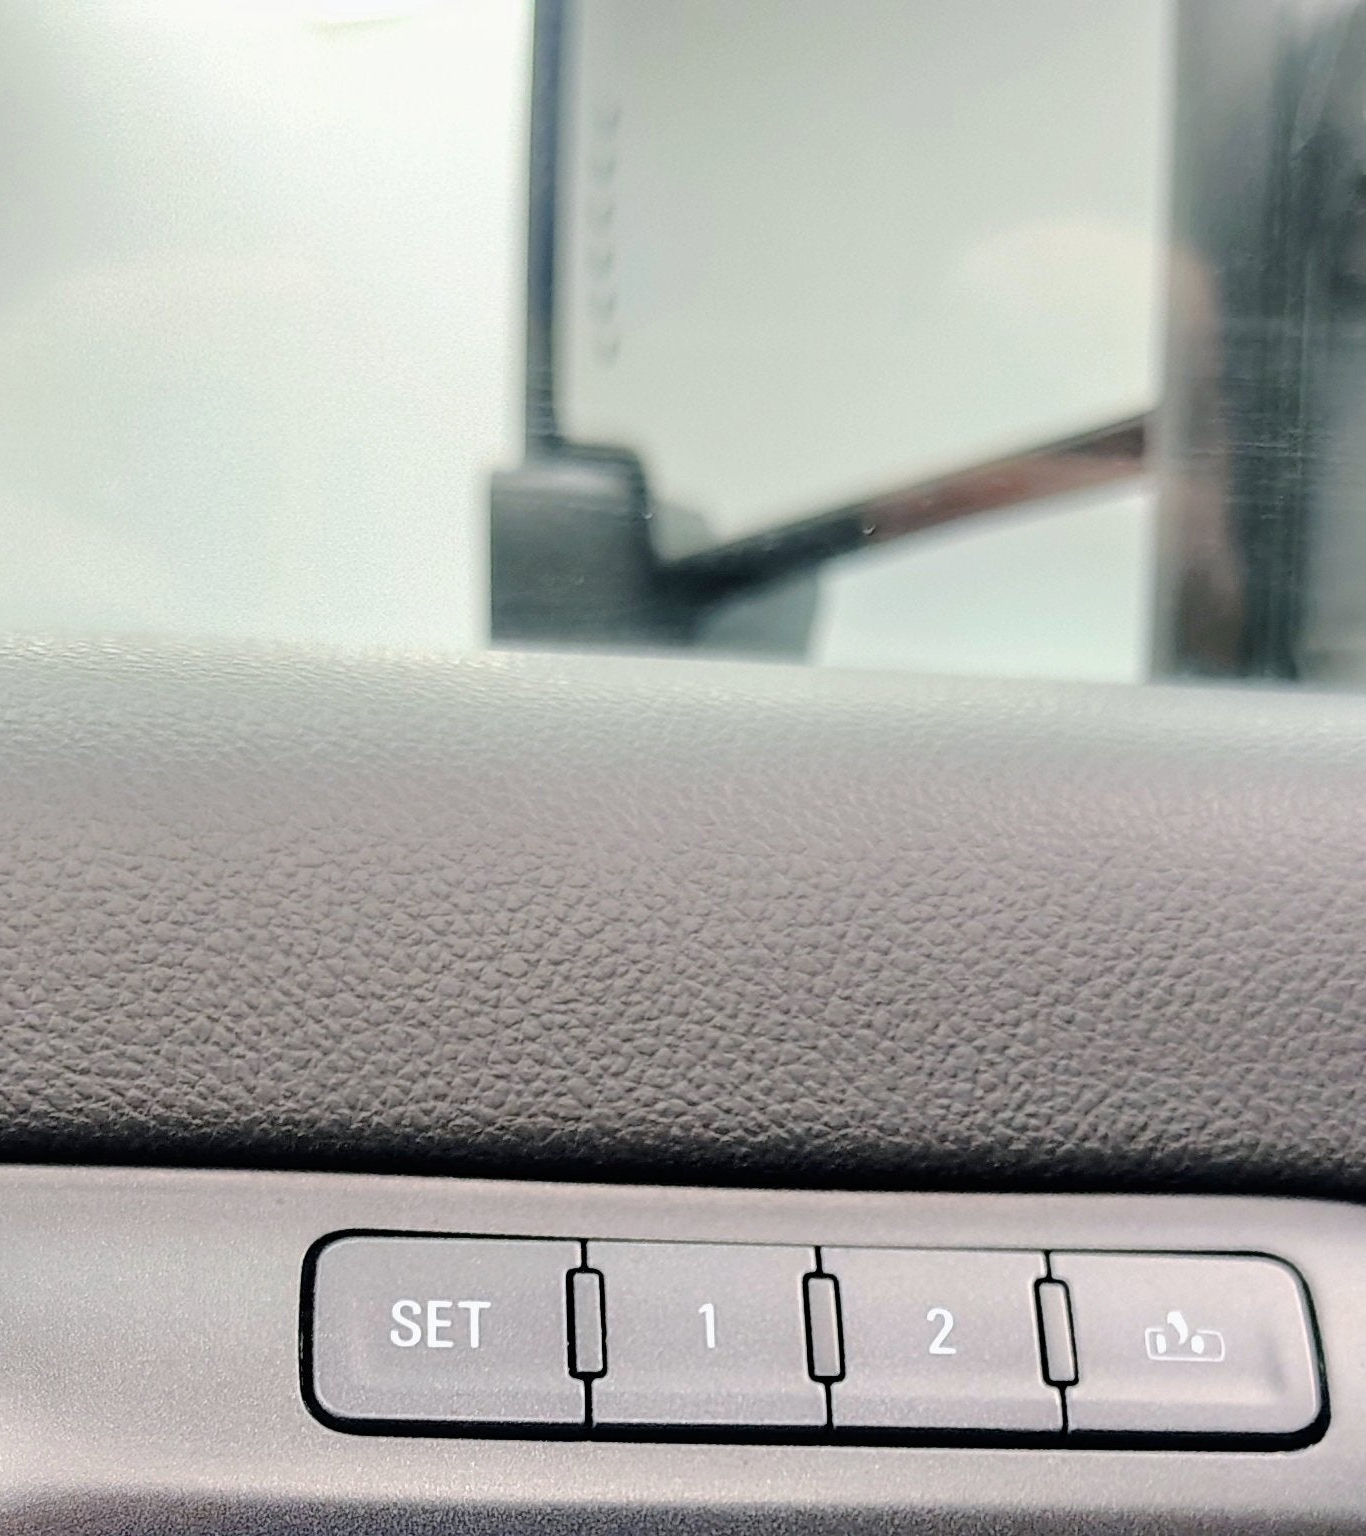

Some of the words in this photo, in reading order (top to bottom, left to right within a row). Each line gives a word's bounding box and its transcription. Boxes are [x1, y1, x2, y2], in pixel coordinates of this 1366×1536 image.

[389, 1300, 491, 1350] SET
[697, 1303, 717, 1350] 1
[925, 1307, 957, 1356] 2
